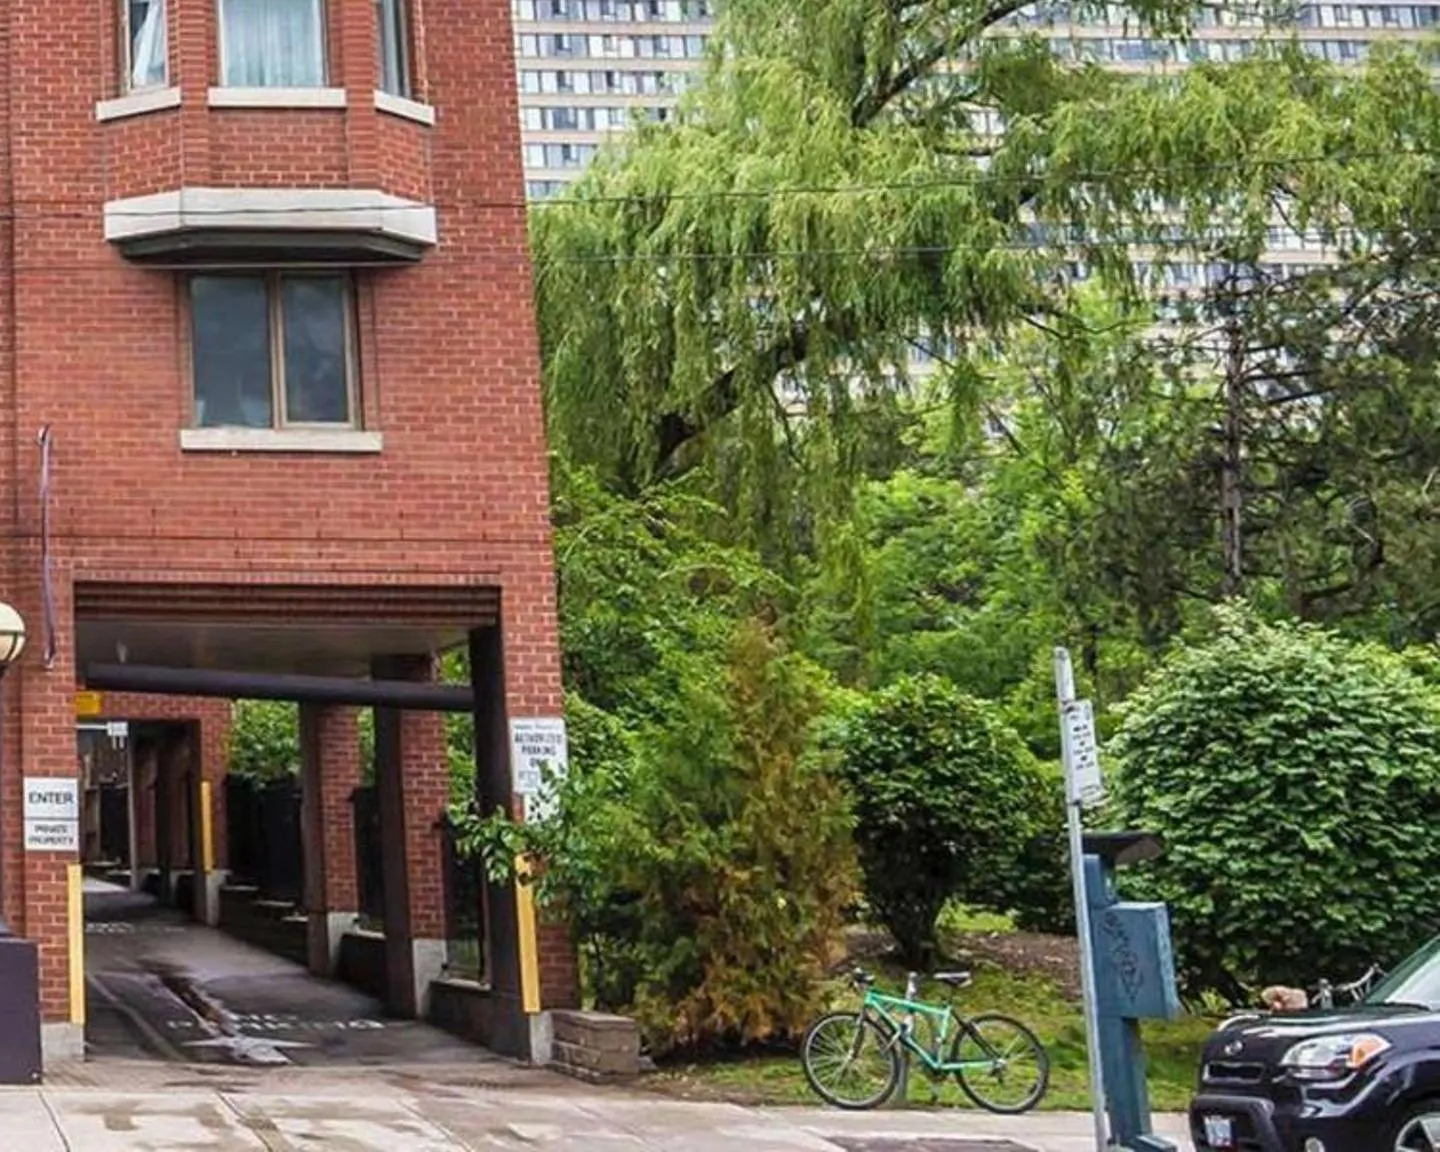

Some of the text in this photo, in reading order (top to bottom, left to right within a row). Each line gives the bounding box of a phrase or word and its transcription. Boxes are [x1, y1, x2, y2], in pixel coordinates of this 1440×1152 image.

[28, 791, 74, 805] ENTER
[34, 824, 68, 833] PRIVATE
[28, 836, 74, 845] PROPERTY
